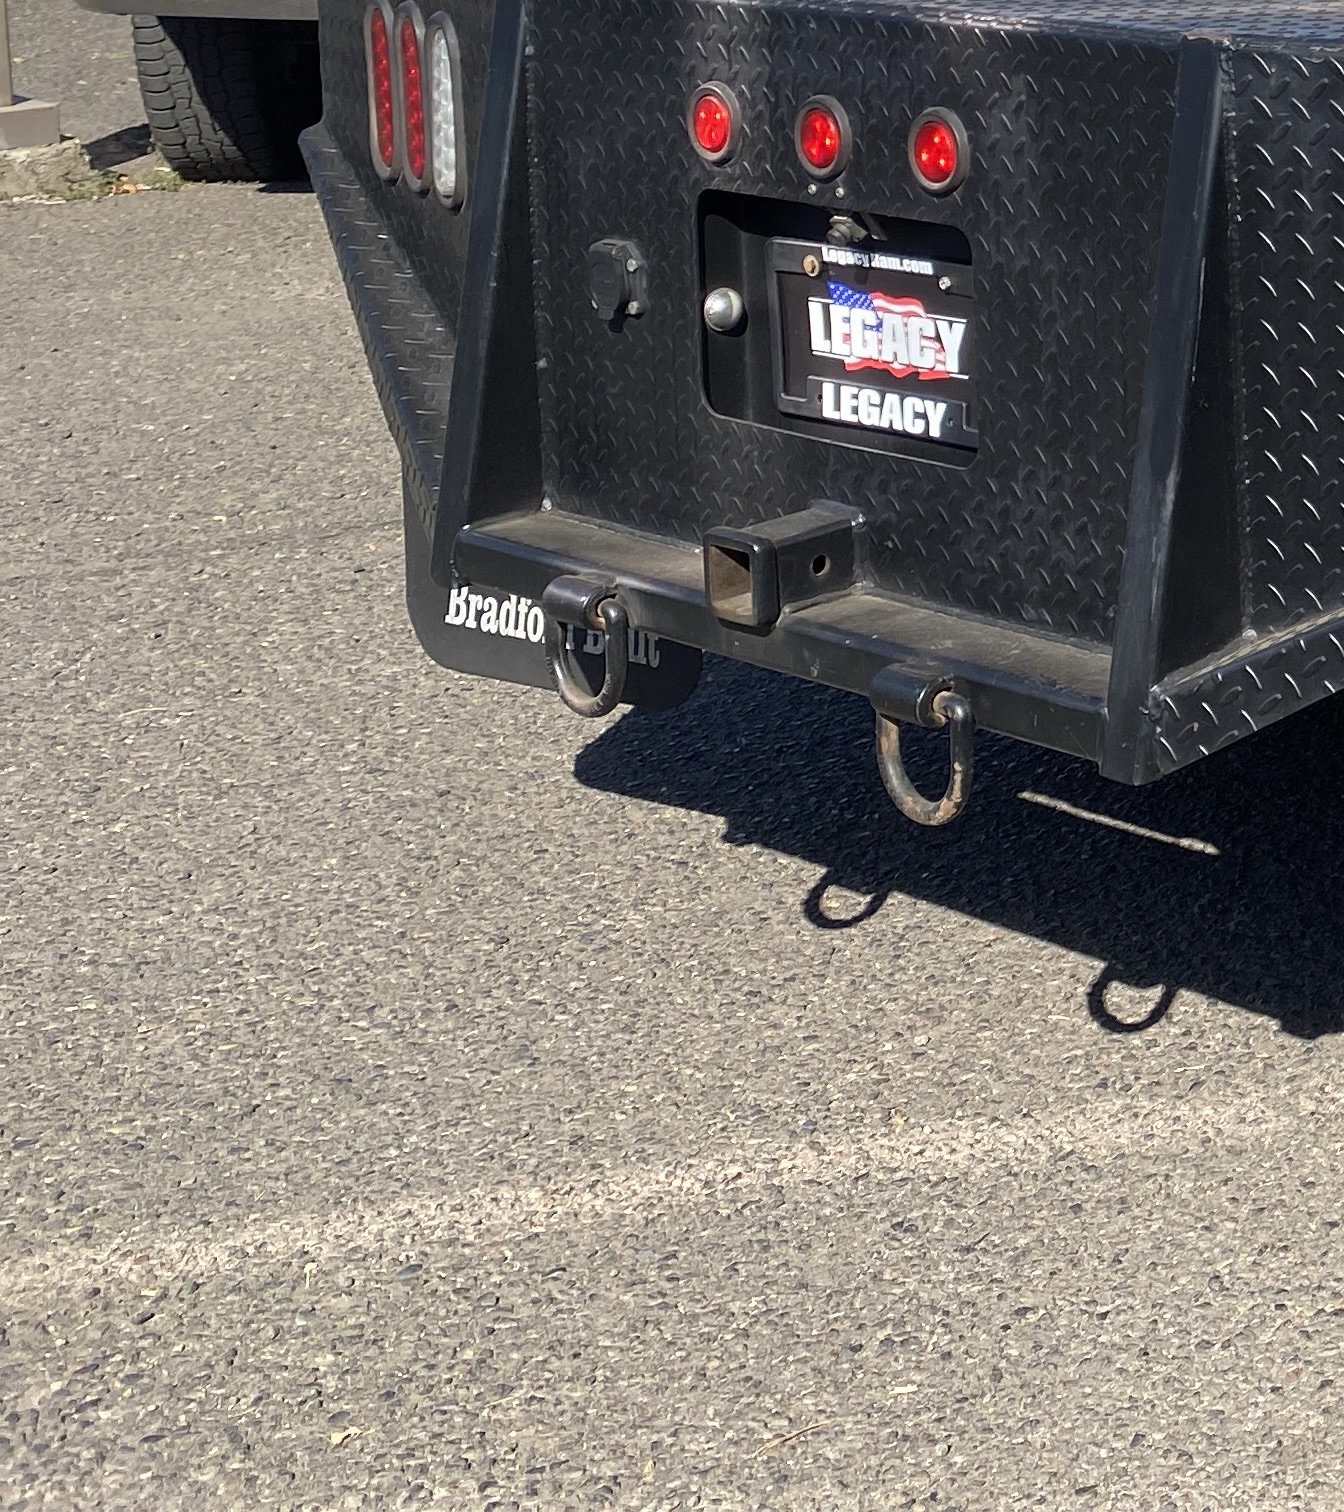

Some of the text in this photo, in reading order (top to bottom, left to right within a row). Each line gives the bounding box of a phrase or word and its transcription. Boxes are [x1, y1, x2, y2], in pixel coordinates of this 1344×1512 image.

[809, 301, 967, 375] LEGACY
[822, 381, 948, 438] LEGACY
[445, 586, 574, 650] Bradfo
